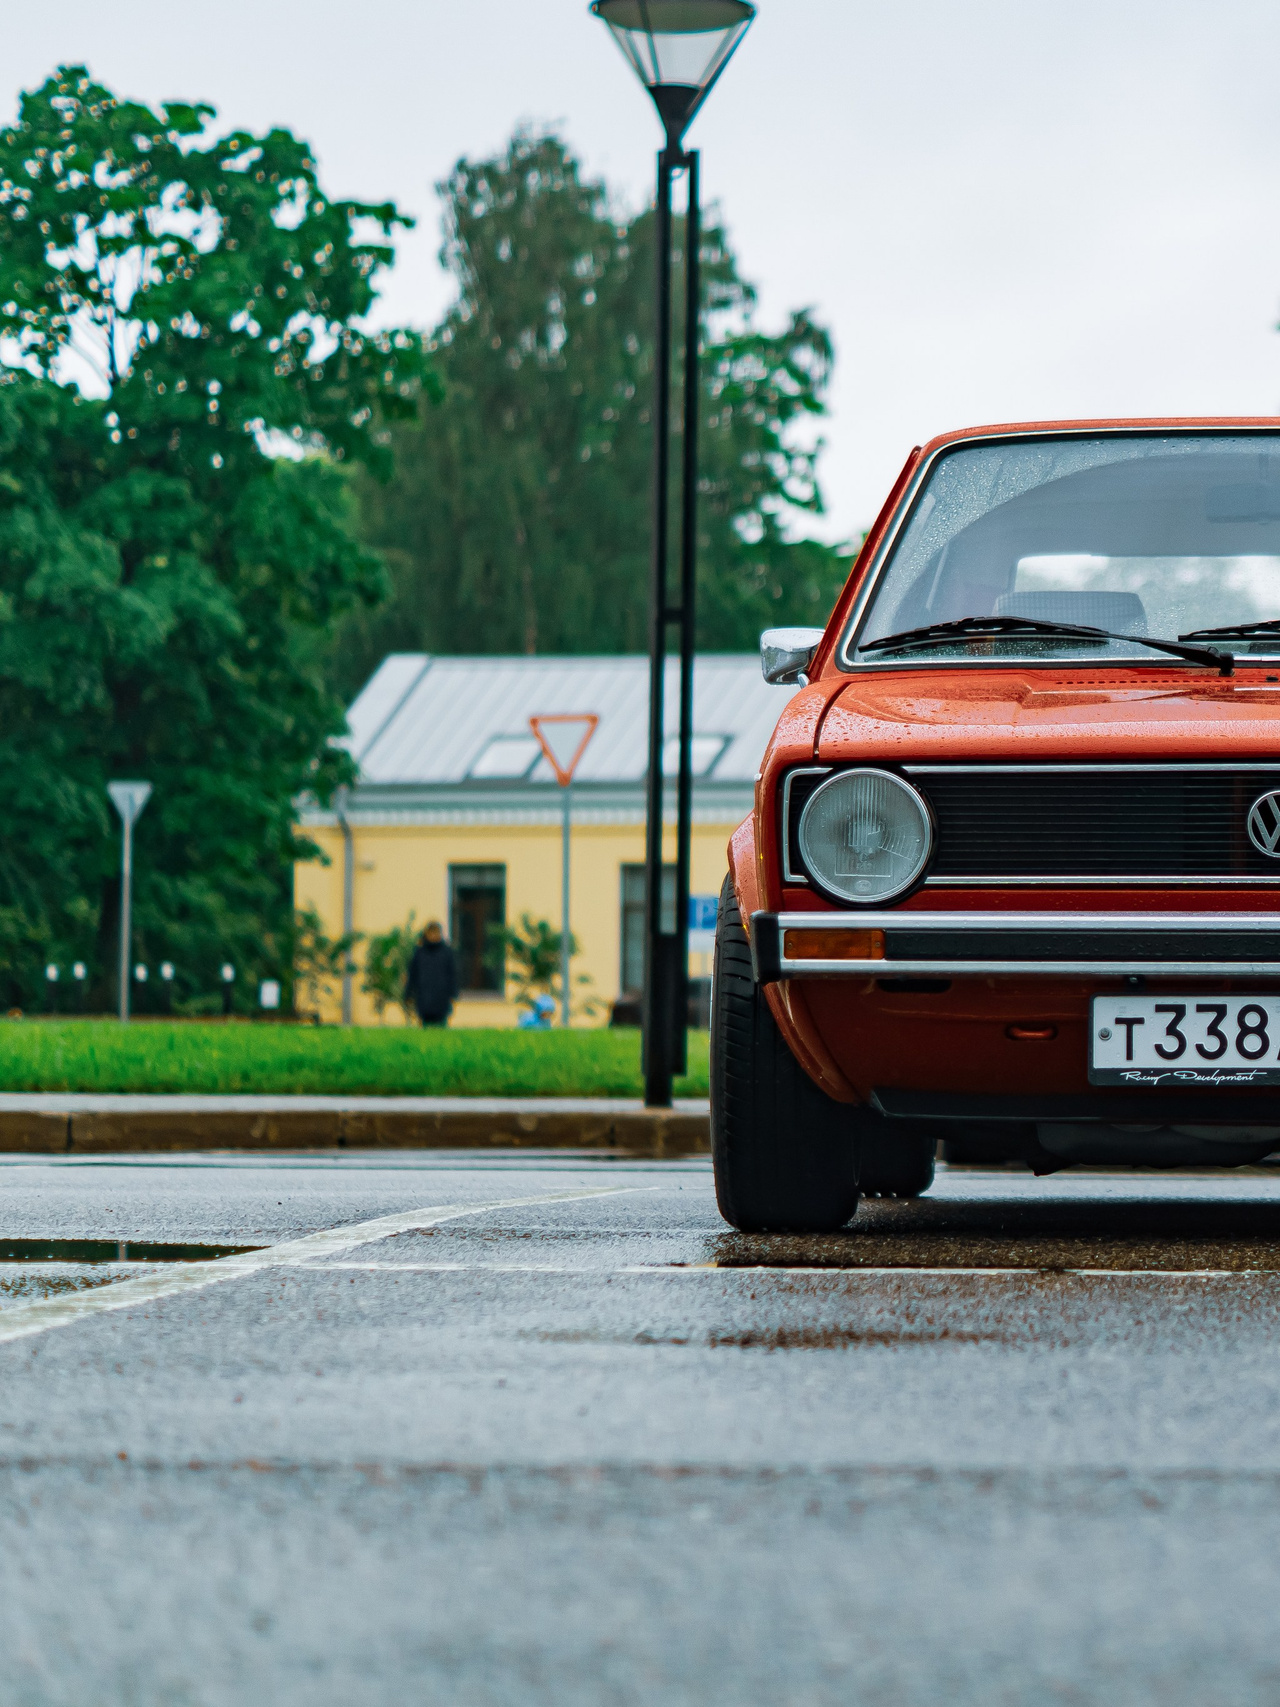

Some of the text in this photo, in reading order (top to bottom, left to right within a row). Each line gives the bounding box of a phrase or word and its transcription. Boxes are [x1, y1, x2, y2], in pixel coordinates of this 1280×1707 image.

[696, 899, 715, 928] P
[1120, 1069, 1267, 1085] Racing Development
